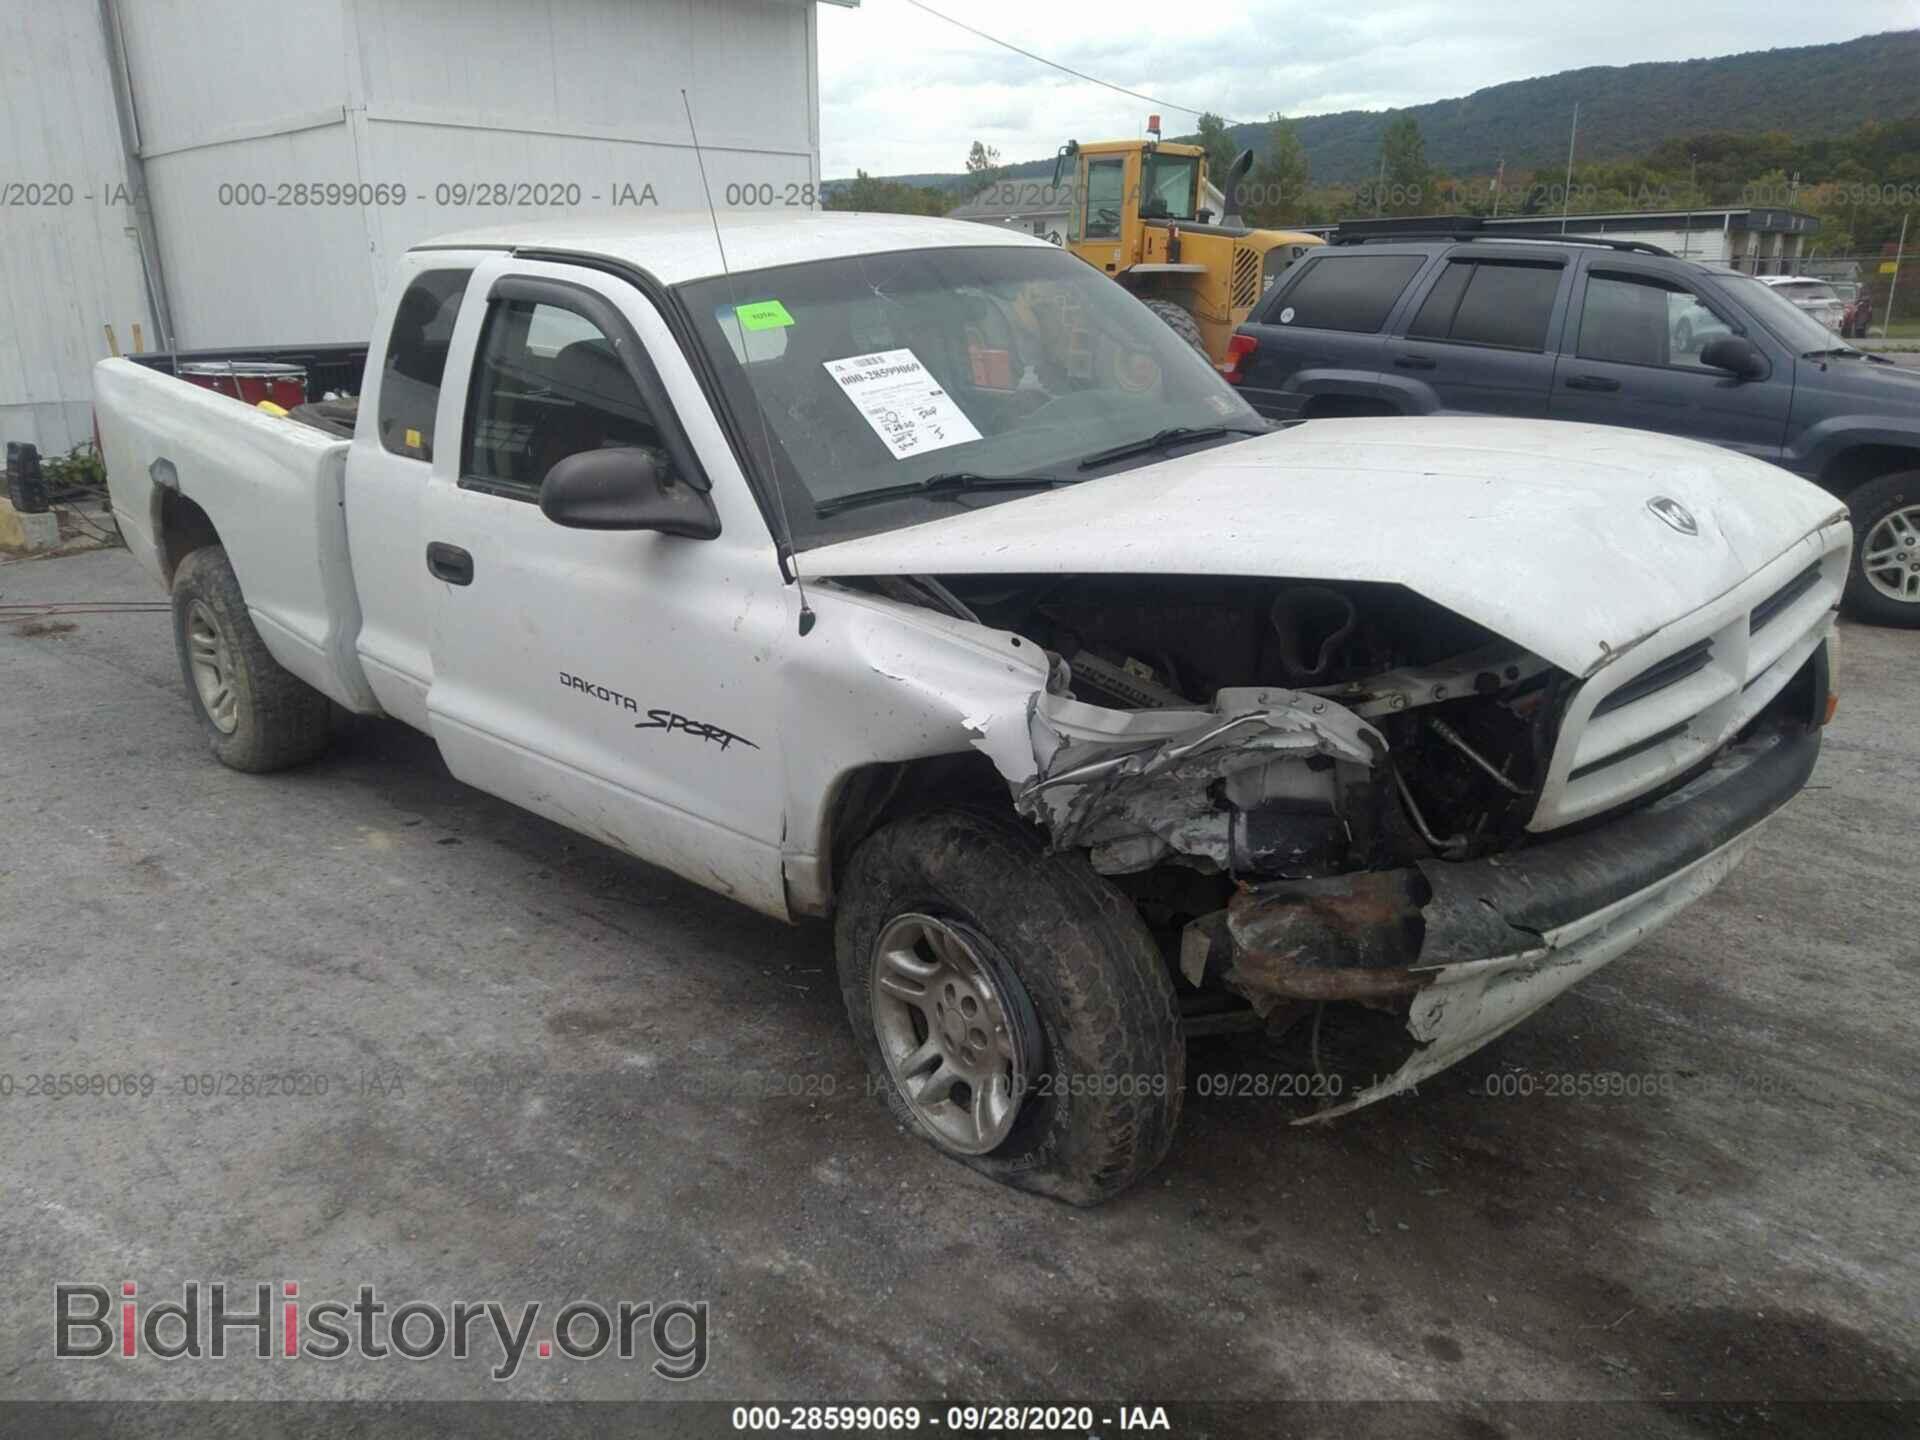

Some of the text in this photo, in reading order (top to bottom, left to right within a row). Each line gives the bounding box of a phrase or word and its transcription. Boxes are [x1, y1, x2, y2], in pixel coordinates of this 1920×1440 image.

[840, 362, 922, 387] 000-28599069
[559, 671, 638, 713] DAKOTA
[634, 709, 761, 752] SPORT
